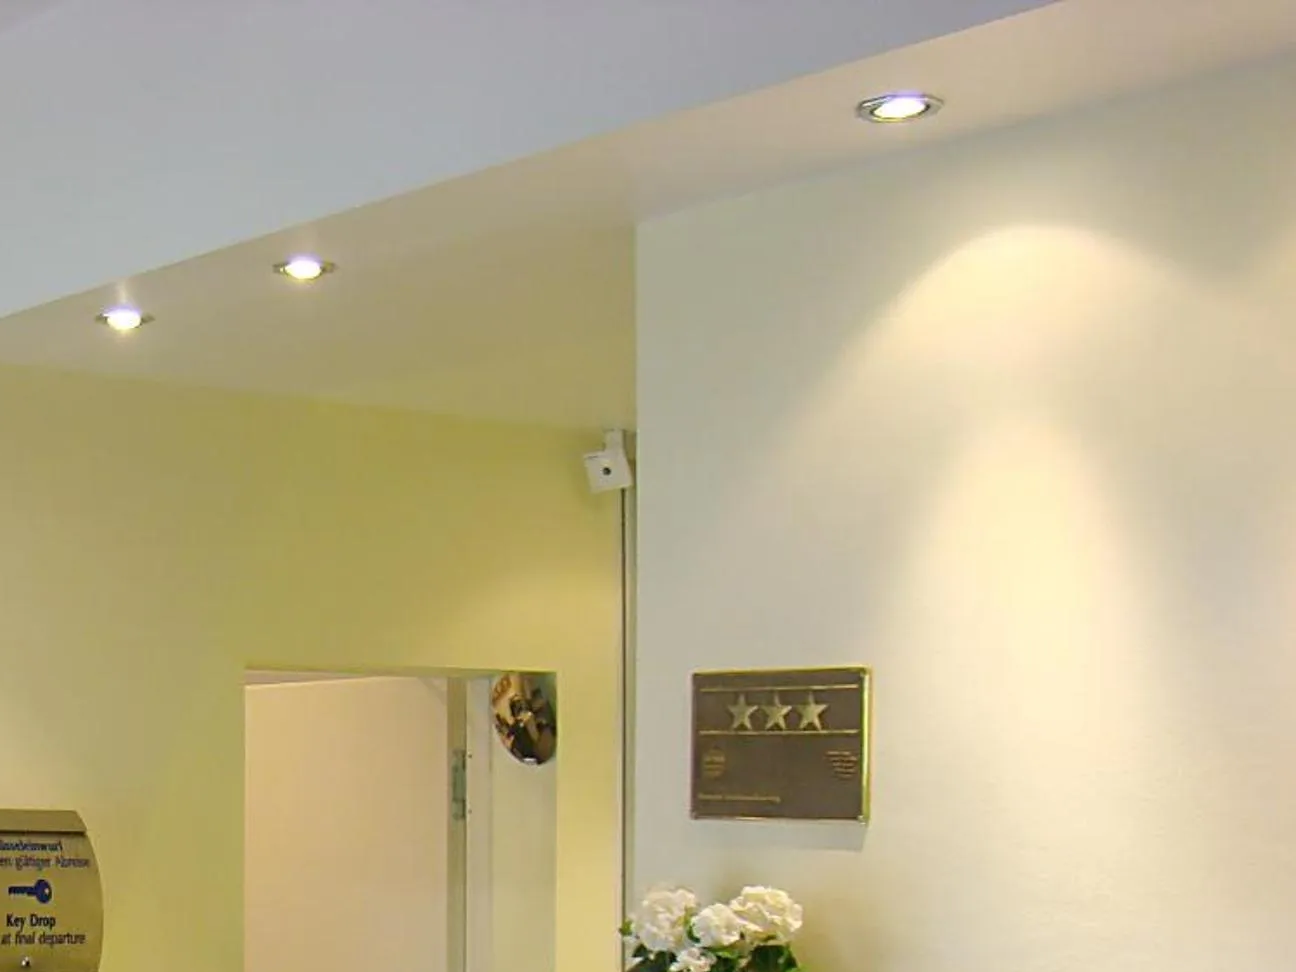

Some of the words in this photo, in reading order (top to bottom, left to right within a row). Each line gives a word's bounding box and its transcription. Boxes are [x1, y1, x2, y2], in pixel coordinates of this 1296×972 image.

[6, 912, 26, 931] Key
[29, 913, 56, 930] Drop
[1, 932, 11, 945] at
[14, 930, 35, 945] final
[39, 931, 86, 947] departure
